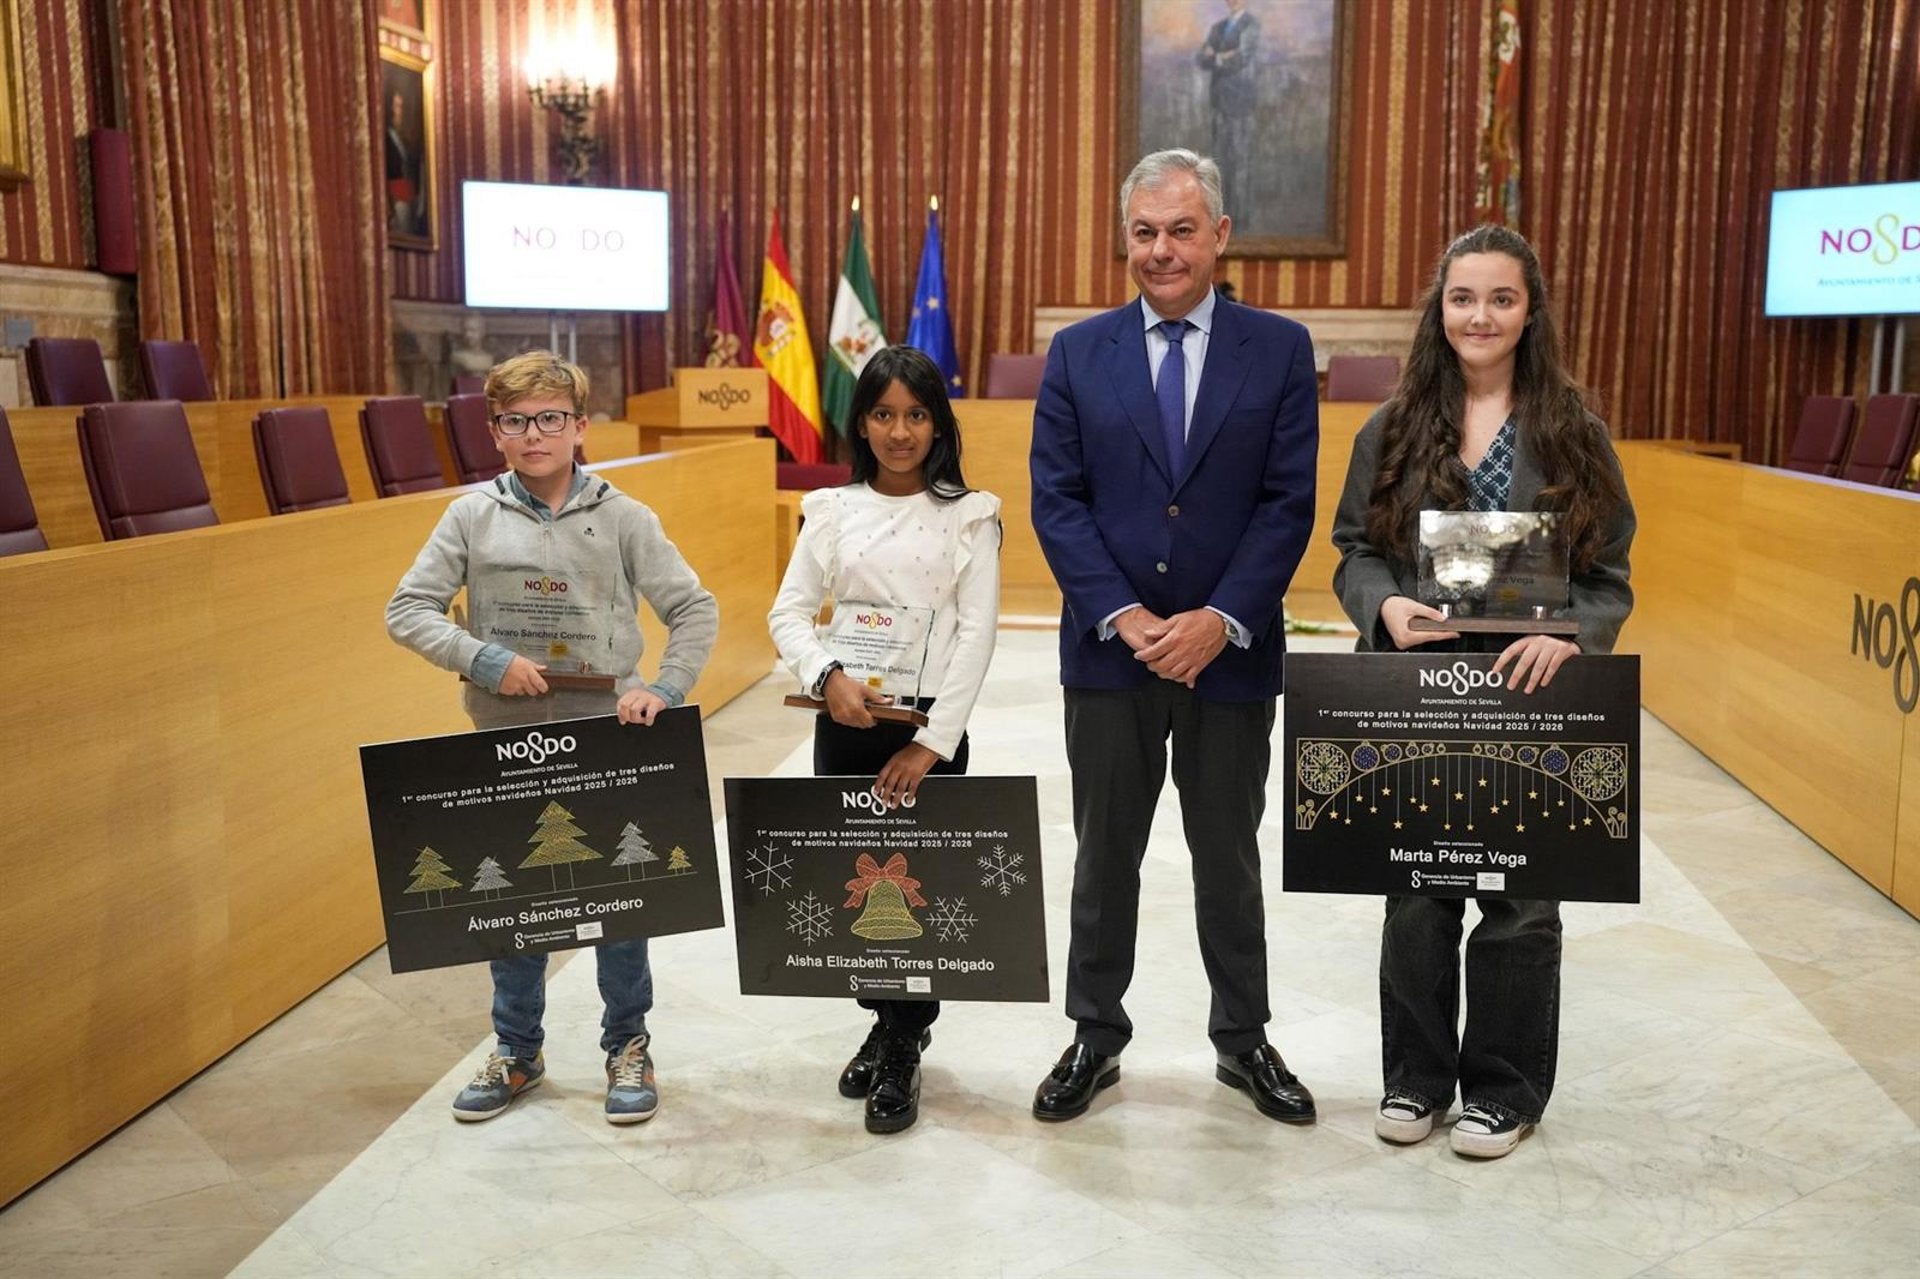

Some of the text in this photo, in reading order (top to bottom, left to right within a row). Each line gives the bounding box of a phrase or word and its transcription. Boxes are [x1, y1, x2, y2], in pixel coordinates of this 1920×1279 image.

[1332, 710, 1375, 718] concurso
[1377, 711, 1399, 719] para
[1402, 710, 1411, 718] la
[1413, 710, 1459, 719] selección
[1462, 712, 1468, 720] y
[1471, 711, 1526, 721] adquisición
[1529, 712, 1541, 720] de
[1544, 712, 1564, 720] tres
[1566, 712, 1605, 721] diseños
[1357, 720, 1369, 728] de
[1372, 720, 1408, 729] motivos
[1411, 721, 1460, 729] navideños
[1463, 722, 1502, 730] Navidad
[1505, 722, 1529, 730] 2025
[1539, 723, 1564, 731] 2026
[415, 790, 458, 802] concurso
[461, 787, 482, 796] para
[484, 785, 493, 793] la
[496, 780, 540, 791] selección
[551, 772, 602, 785] adquisición
[605, 770, 617, 778] de
[619, 768, 637, 776] tres
[640, 763, 675, 774] diseños
[457, 796, 493, 806] motivos
[495, 790, 542, 802] navideños
[544, 784, 582, 795] Navidad
[584, 781, 607, 790] 2025
[616, 776, 638, 786] 2026
[808, 831, 827, 839] para
[882, 831, 888, 839] y
[890, 830, 939, 839] adquisición
[941, 830, 952, 838] de
[974, 830, 1008, 838] diseños
[839, 839, 881, 847] navideños
[951, 840, 972, 848] 2026
[1389, 848, 1527, 868] Marta Pérez Vega
[468, 916, 514, 932] Álvaro
[518, 906, 582, 924] Sánchez
[585, 897, 644, 915] Cordero
[786, 954, 995, 973] Aisha Elizabeth Torres Delgado
